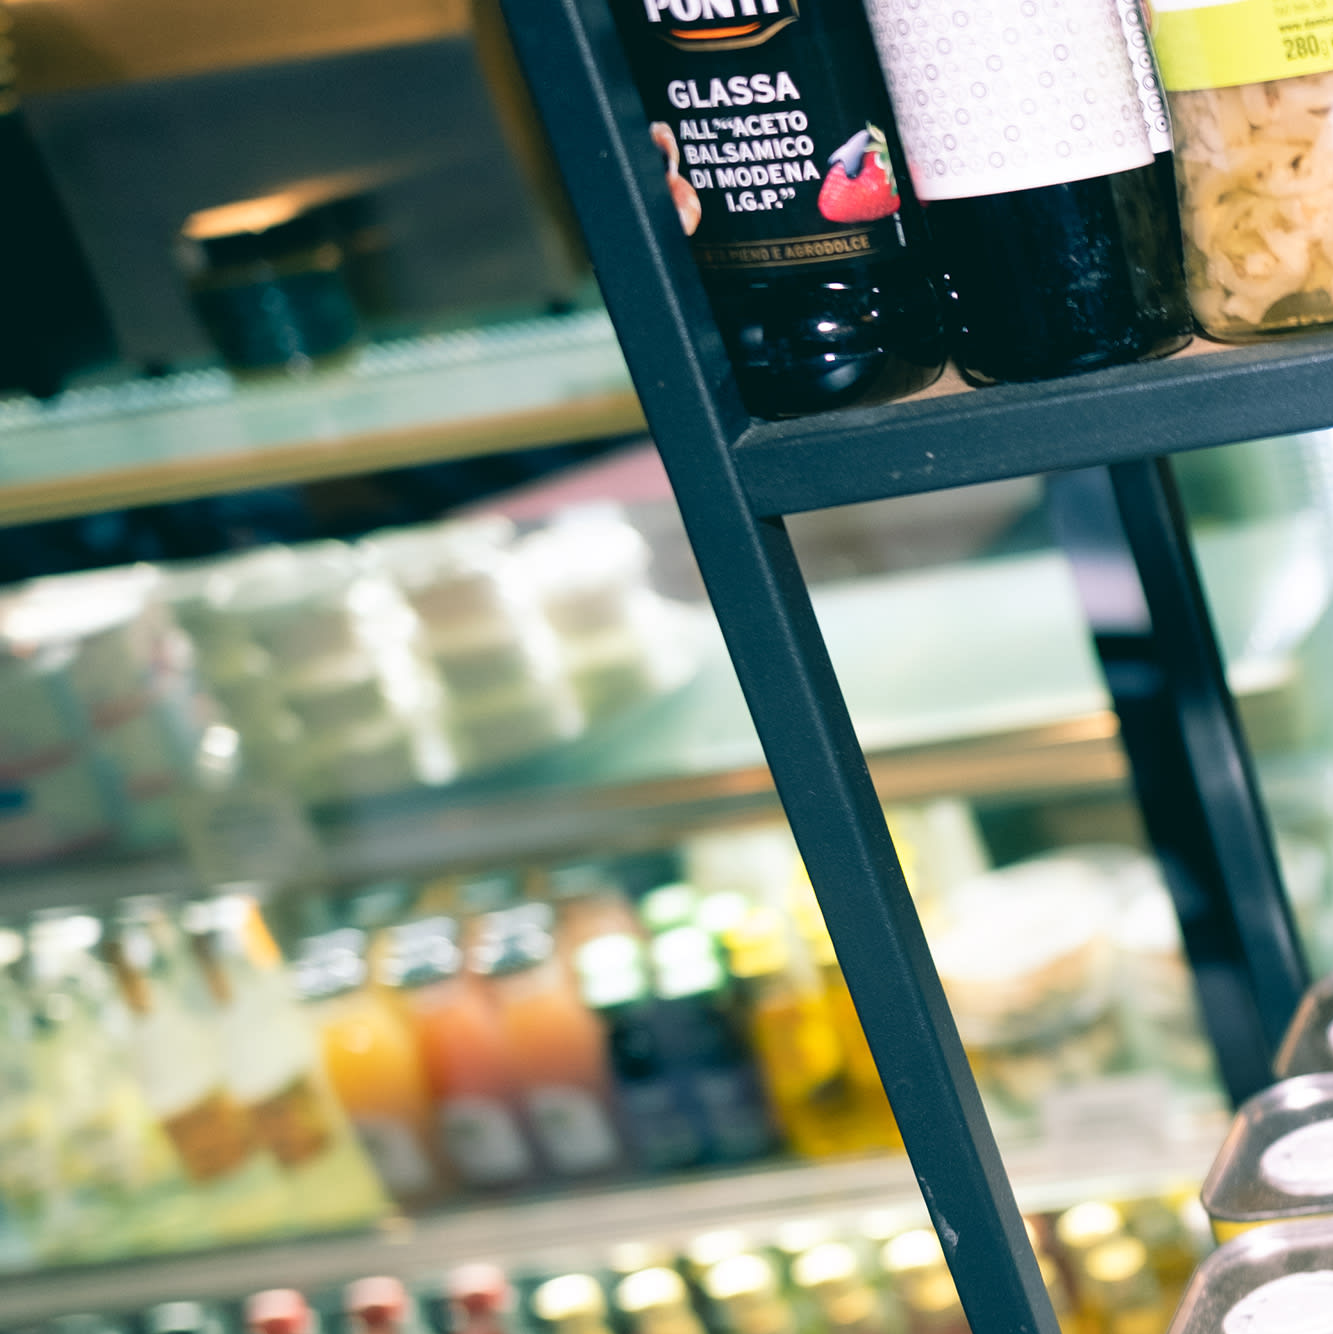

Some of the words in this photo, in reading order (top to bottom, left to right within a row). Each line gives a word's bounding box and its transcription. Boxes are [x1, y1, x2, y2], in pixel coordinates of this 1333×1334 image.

[667, 71, 801, 109] GLASSA
[683, 135, 815, 165] BALSAMICO
[690, 168, 714, 189] DI
[715, 160, 821, 188] MODENA
